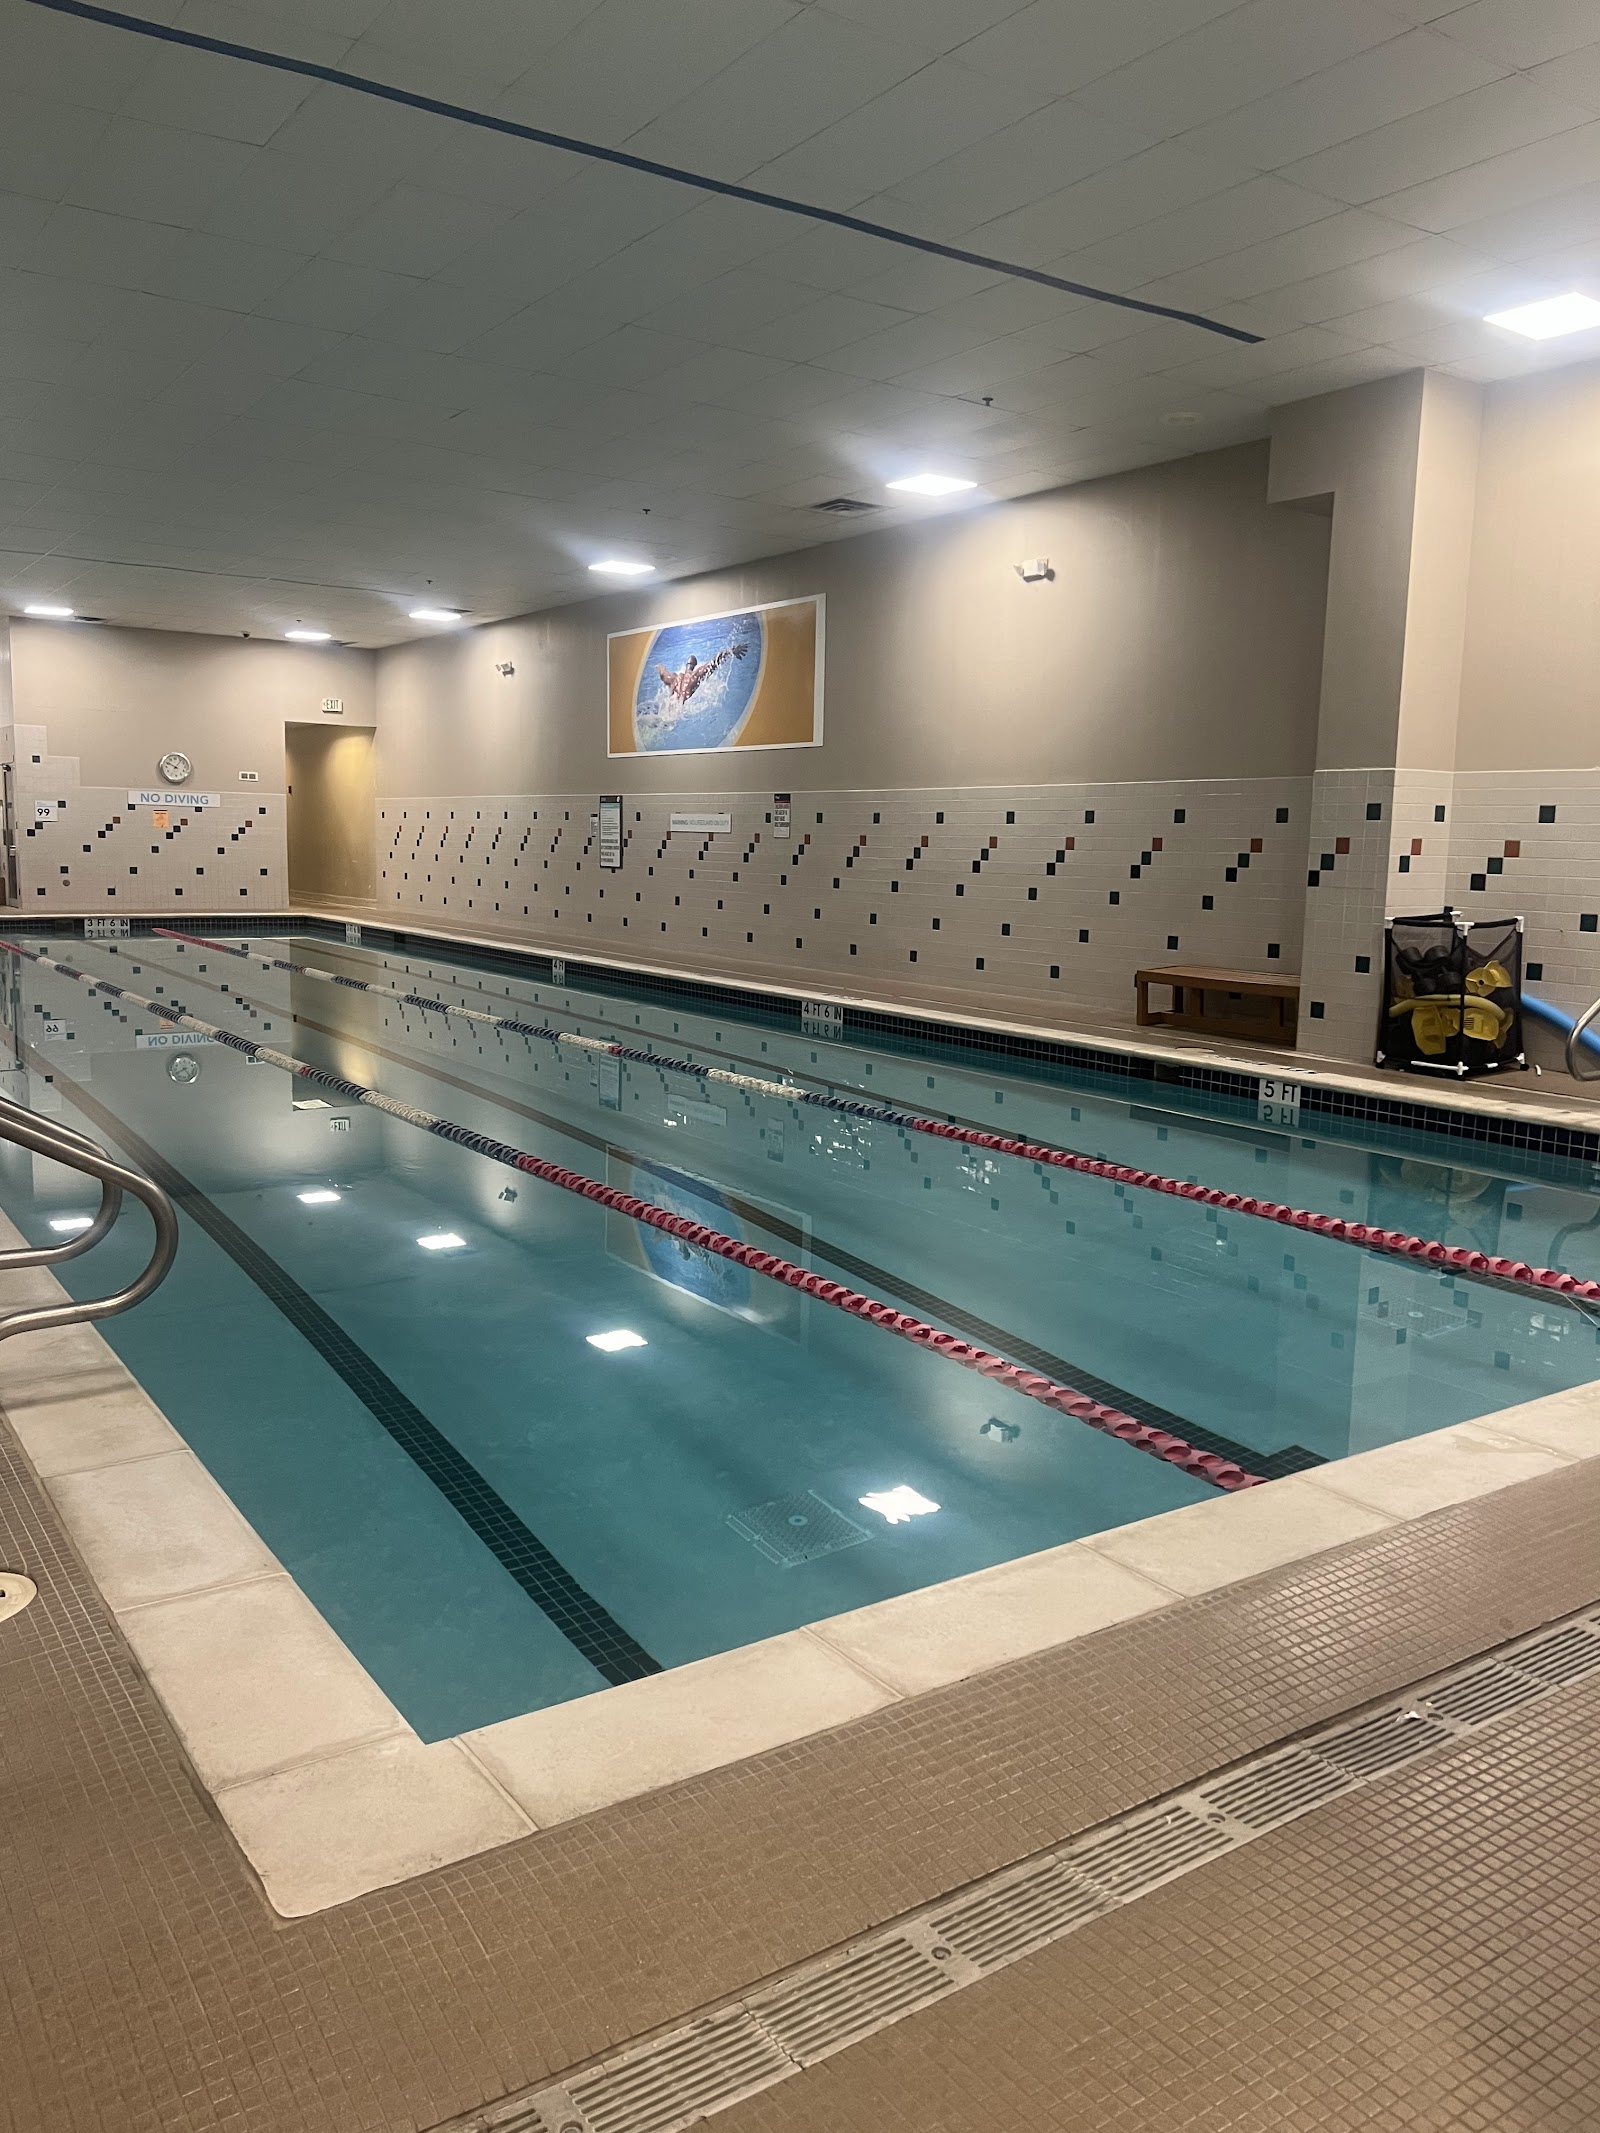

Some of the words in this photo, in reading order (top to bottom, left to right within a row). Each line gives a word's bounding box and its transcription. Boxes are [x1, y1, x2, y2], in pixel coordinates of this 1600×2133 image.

[326, 699, 339, 709] EXIT
[140, 793, 160, 803] NO
[165, 794, 209, 805] DIVING
[37, 808, 50, 816] 99
[87, 919, 93, 927] 3
[97, 919, 105, 927] FT
[110, 919, 116, 927] 6
[120, 919, 129, 927] IN
[804, 1001, 809, 1015] 4
[812, 1003, 820, 1017] FT
[824, 1005, 830, 1018] 6
[833, 1006, 842, 1020] IN
[1264, 1080, 1275, 1098] 5
[1281, 1083, 1298, 1103] FT
